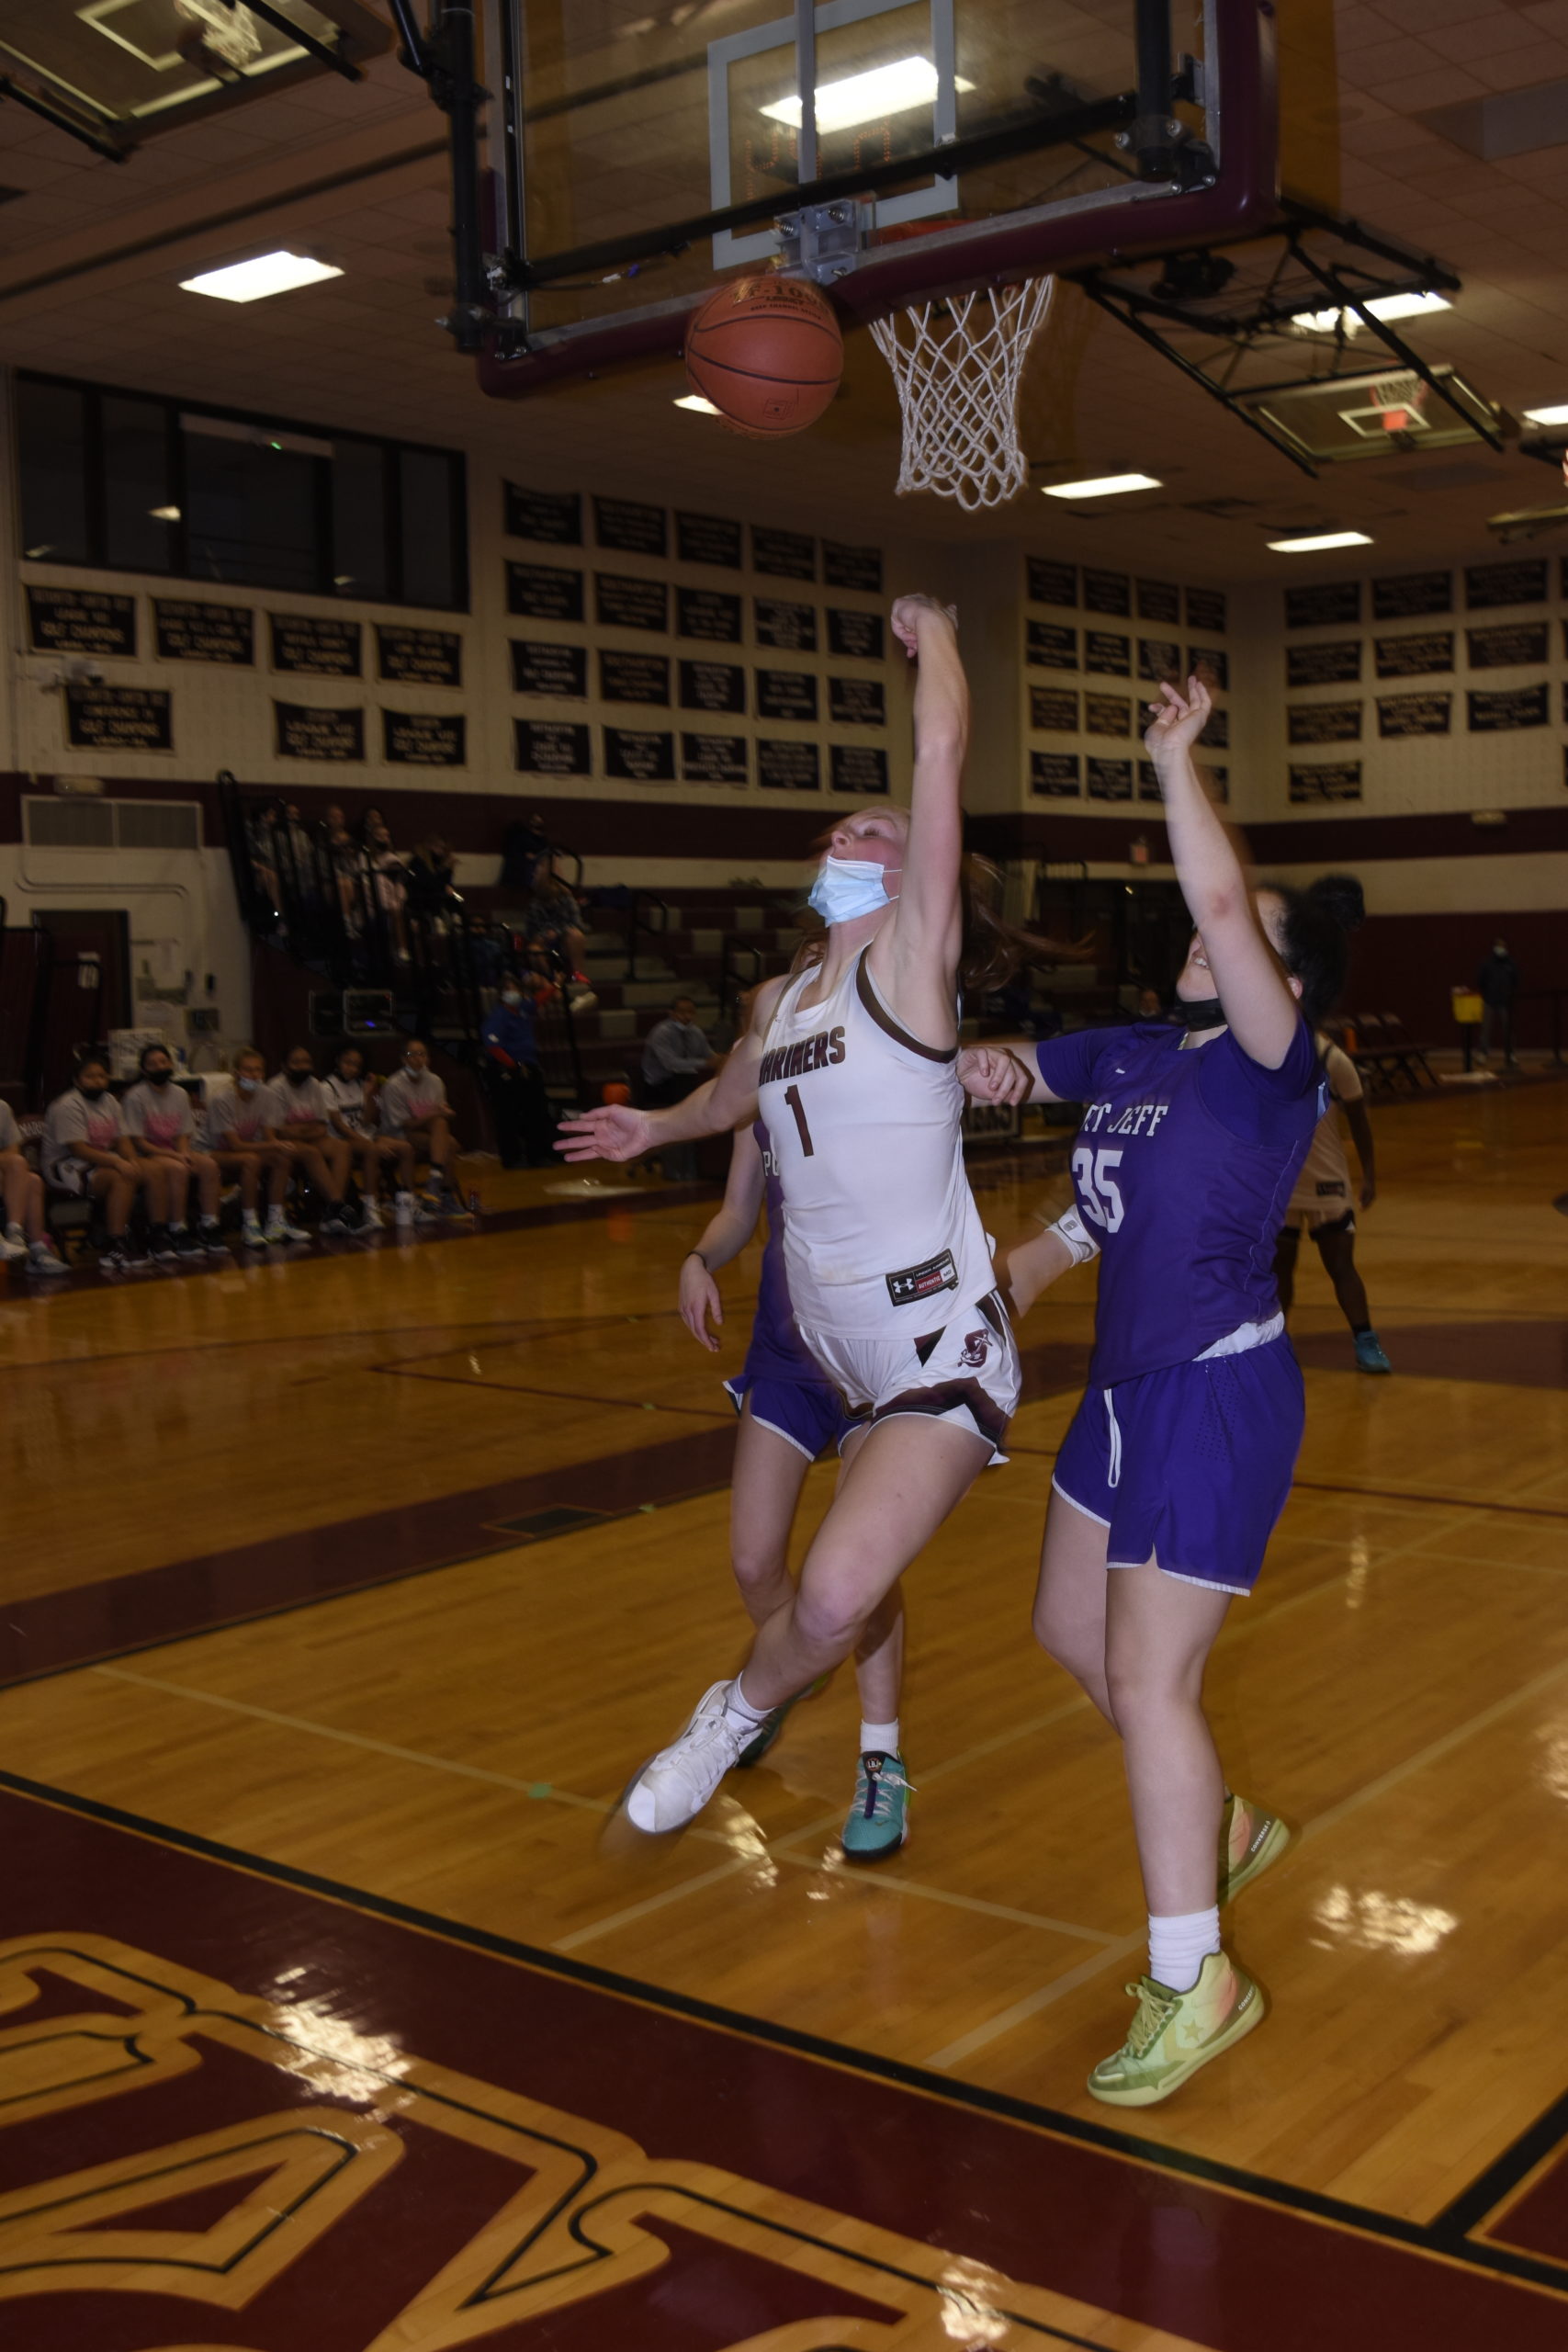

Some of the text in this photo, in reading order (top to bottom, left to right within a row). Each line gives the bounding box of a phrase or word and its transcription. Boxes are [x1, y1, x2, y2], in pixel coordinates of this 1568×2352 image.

[784, 1084, 815, 1157] 1
[1106, 1104, 1169, 1137] JEFF
[1072, 1147, 1125, 1234] 35
[918, 1275, 942, 1290] AUTHENTIC
